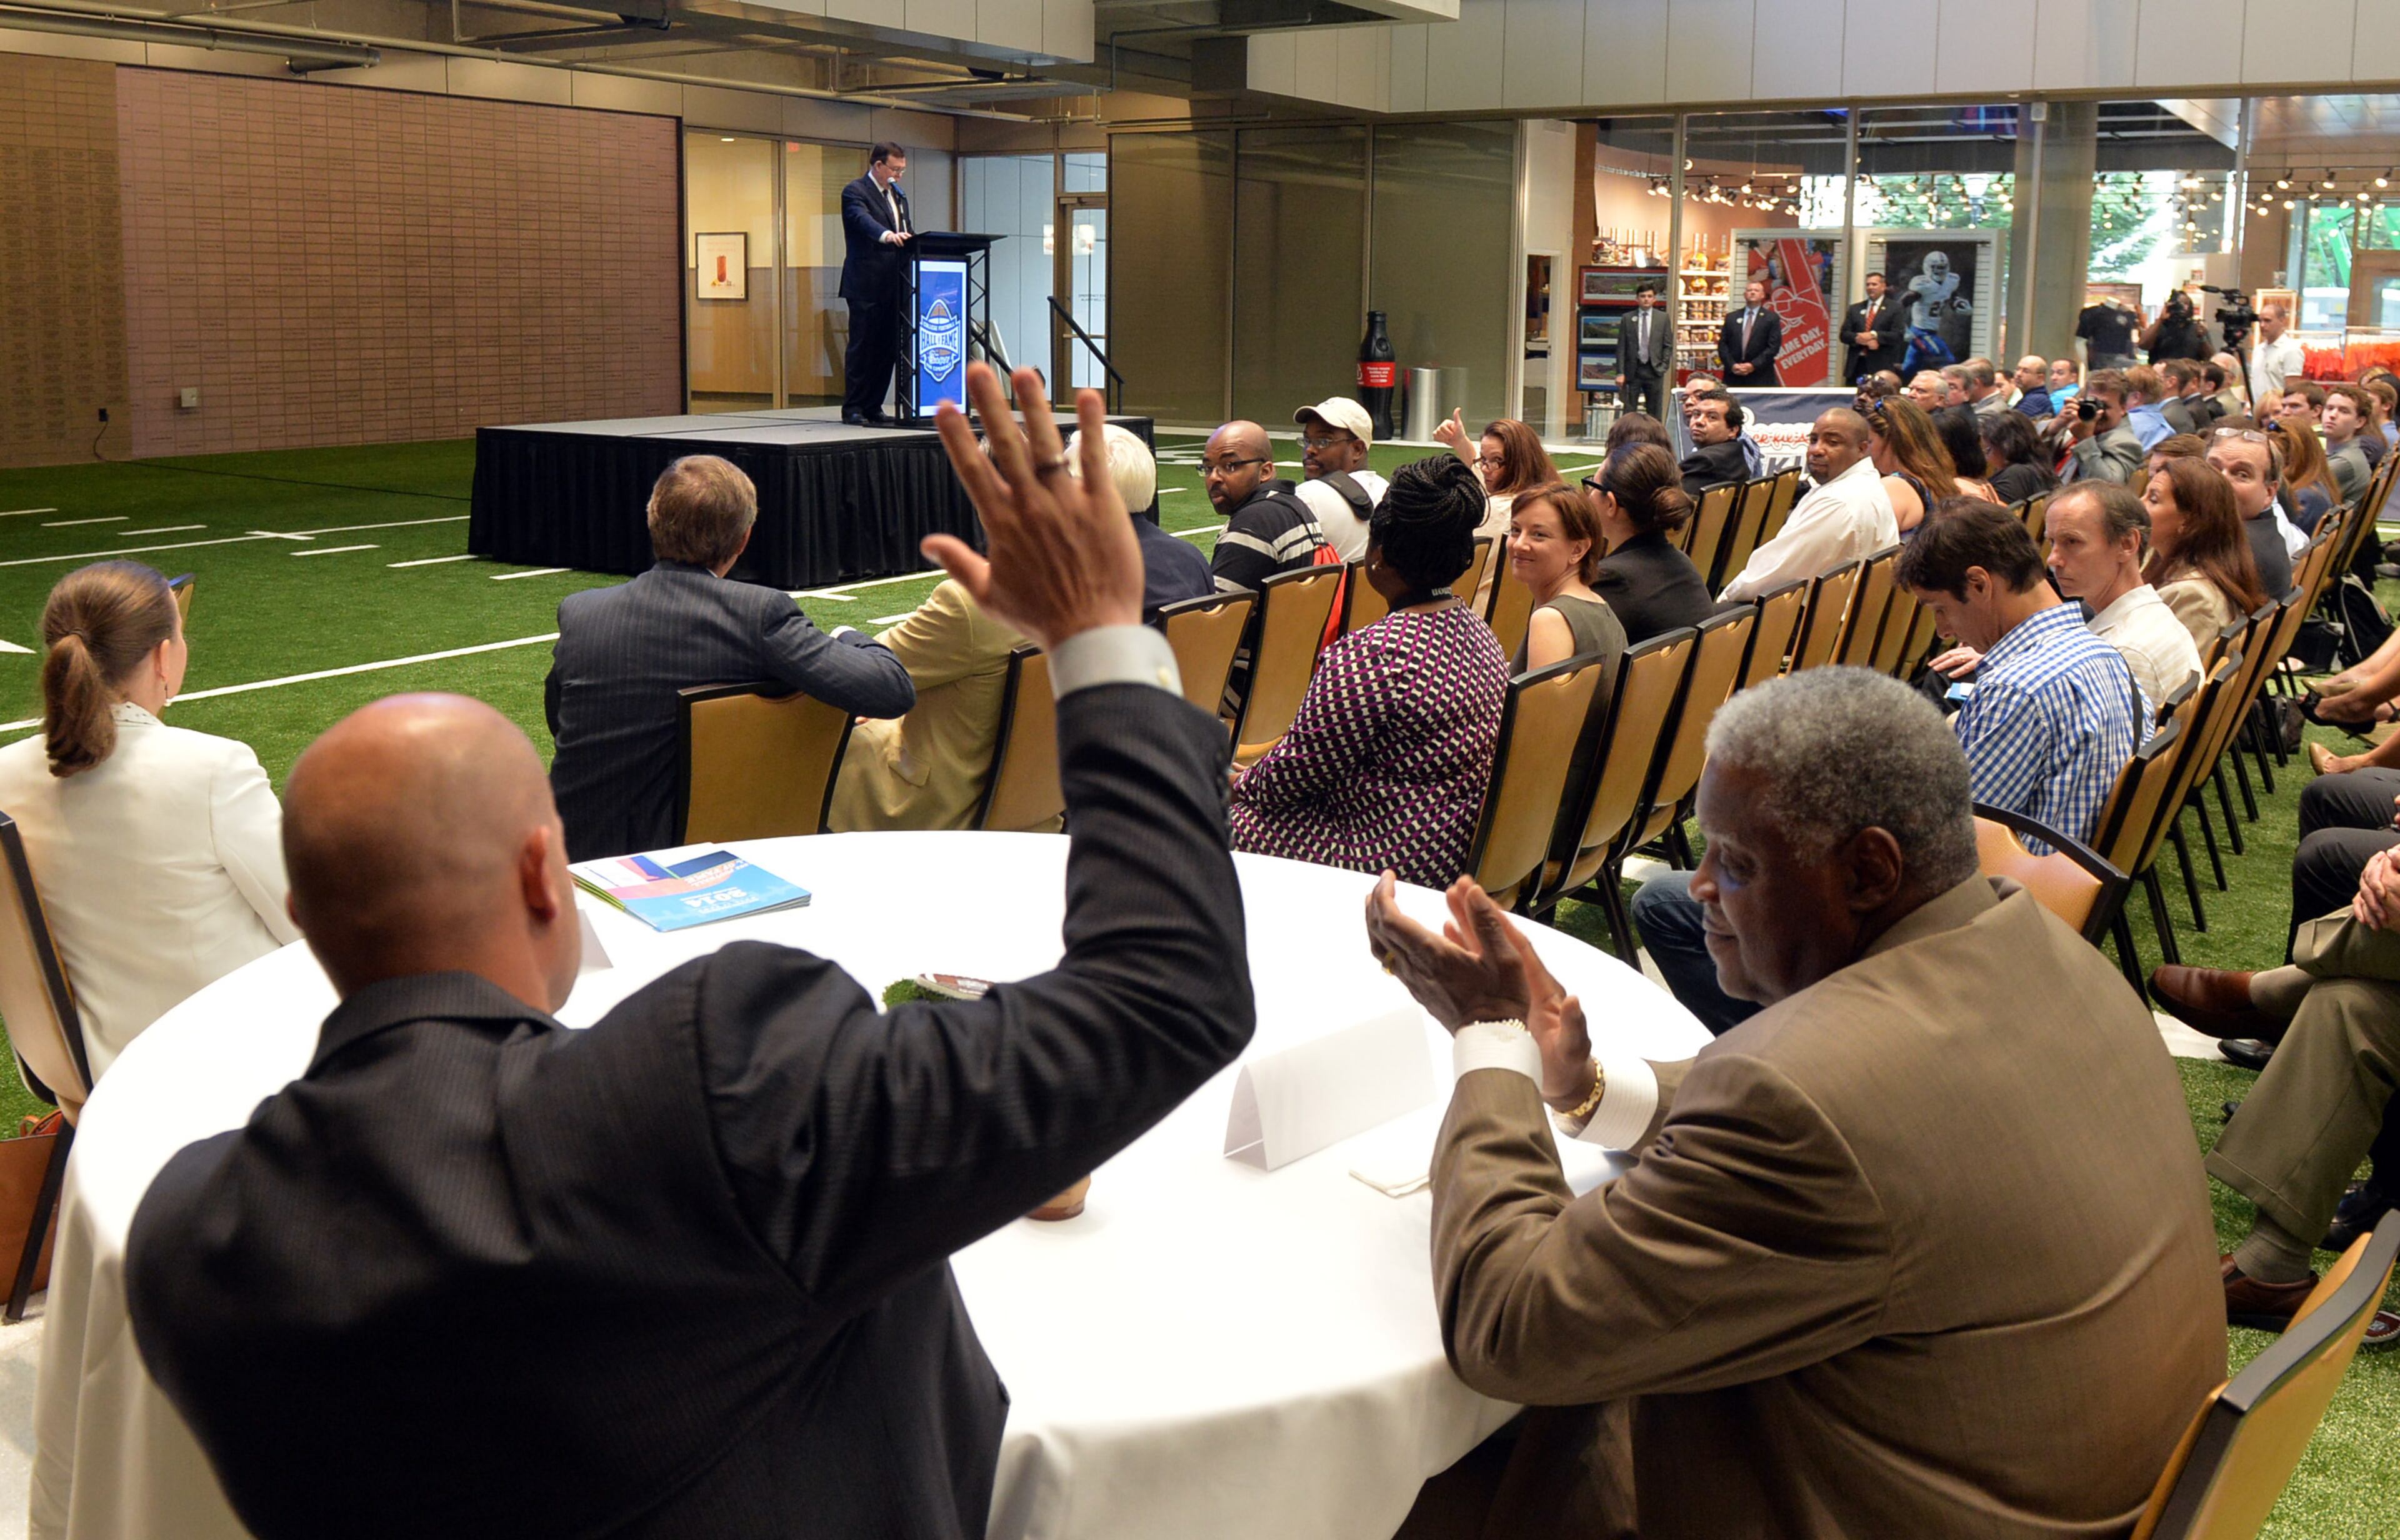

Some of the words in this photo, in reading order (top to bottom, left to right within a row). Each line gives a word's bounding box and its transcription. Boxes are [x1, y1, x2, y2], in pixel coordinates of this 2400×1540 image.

[921, 330, 937, 349] HALL
[941, 330, 957, 350] FAME
[1774, 338, 1801, 359] AME
[1800, 326, 1824, 344] DAY.
[1780, 338, 1828, 370] EVERYDAY.
[684, 891, 747, 908] 2014
